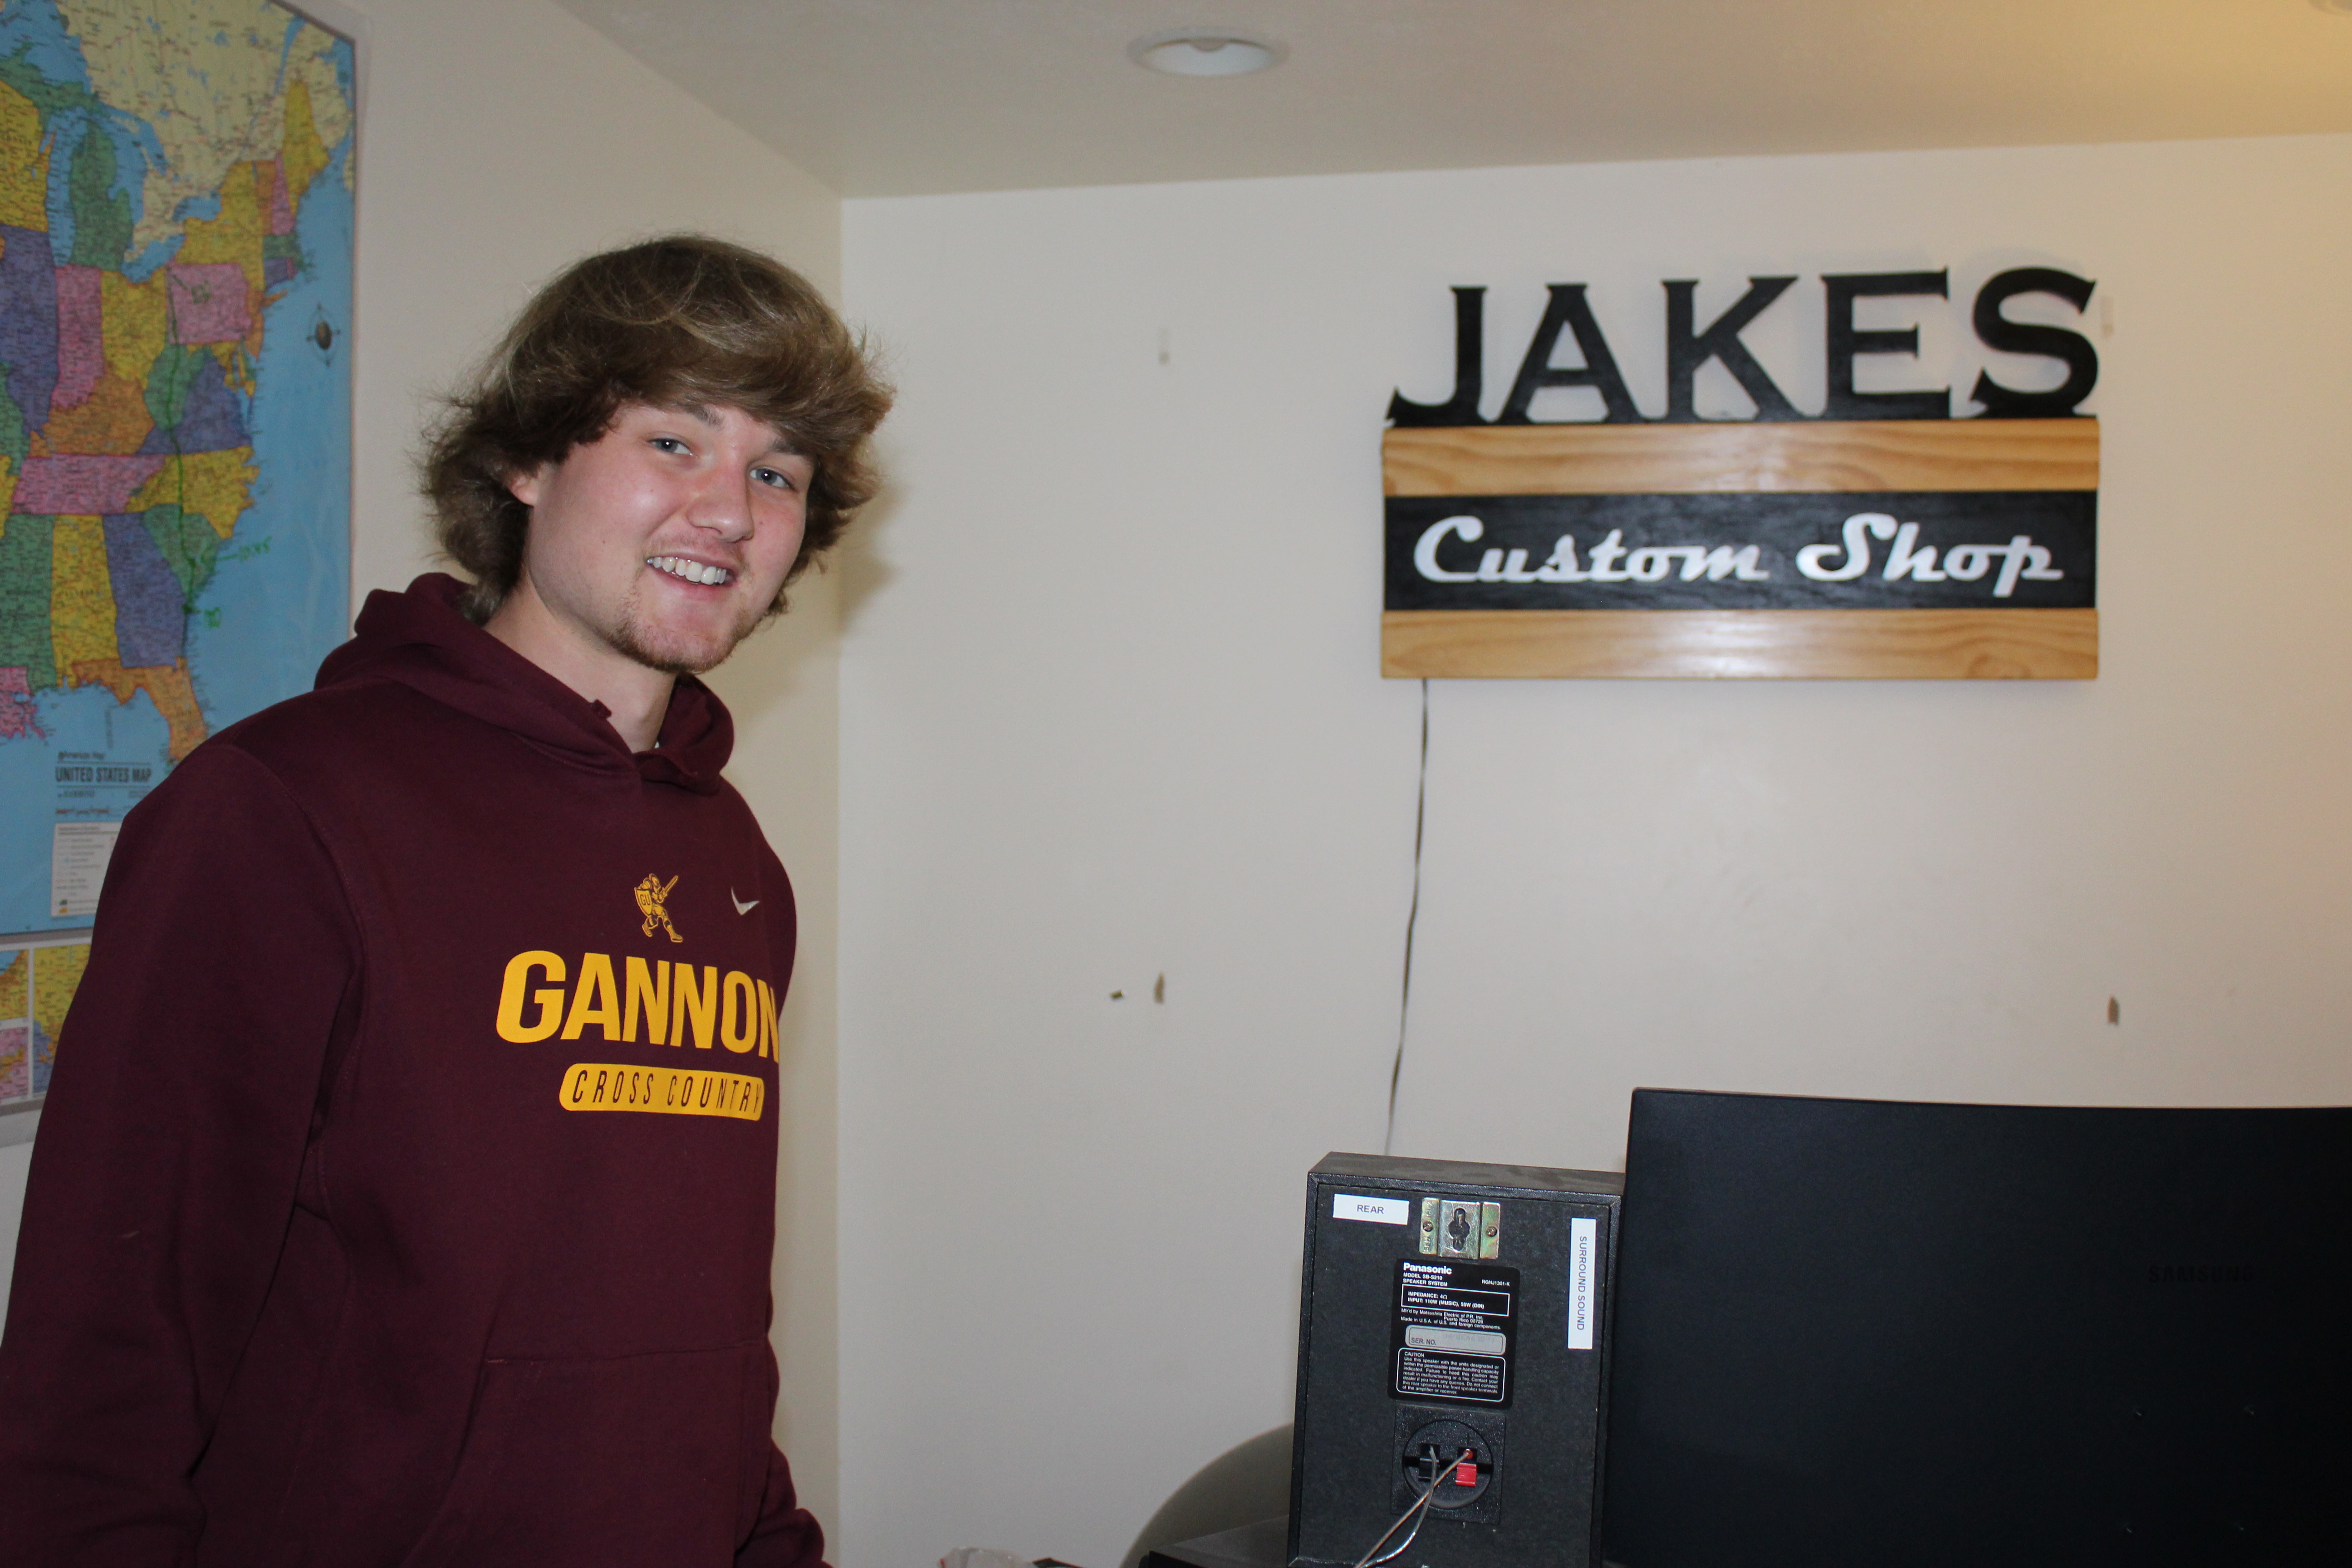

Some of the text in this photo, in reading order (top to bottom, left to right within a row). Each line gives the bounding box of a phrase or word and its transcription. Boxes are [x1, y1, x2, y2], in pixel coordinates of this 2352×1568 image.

[1384, 267, 2098, 426] JAKES
[1414, 512, 2064, 598] Custom Shop
[55, 767, 152, 782] UNITED STATES MAP
[640, 894, 651, 905] GU
[496, 950, 779, 1063] GANNON
[573, 1069, 761, 1114] CROSS COUNTRY
[1357, 1204, 1384, 1215] REAR
[1403, 1262, 1452, 1275] Panasonic
[1577, 1235, 1587, 1331] SURROUND SOUND
[2148, 1265, 2254, 1283] SAMSUNG
